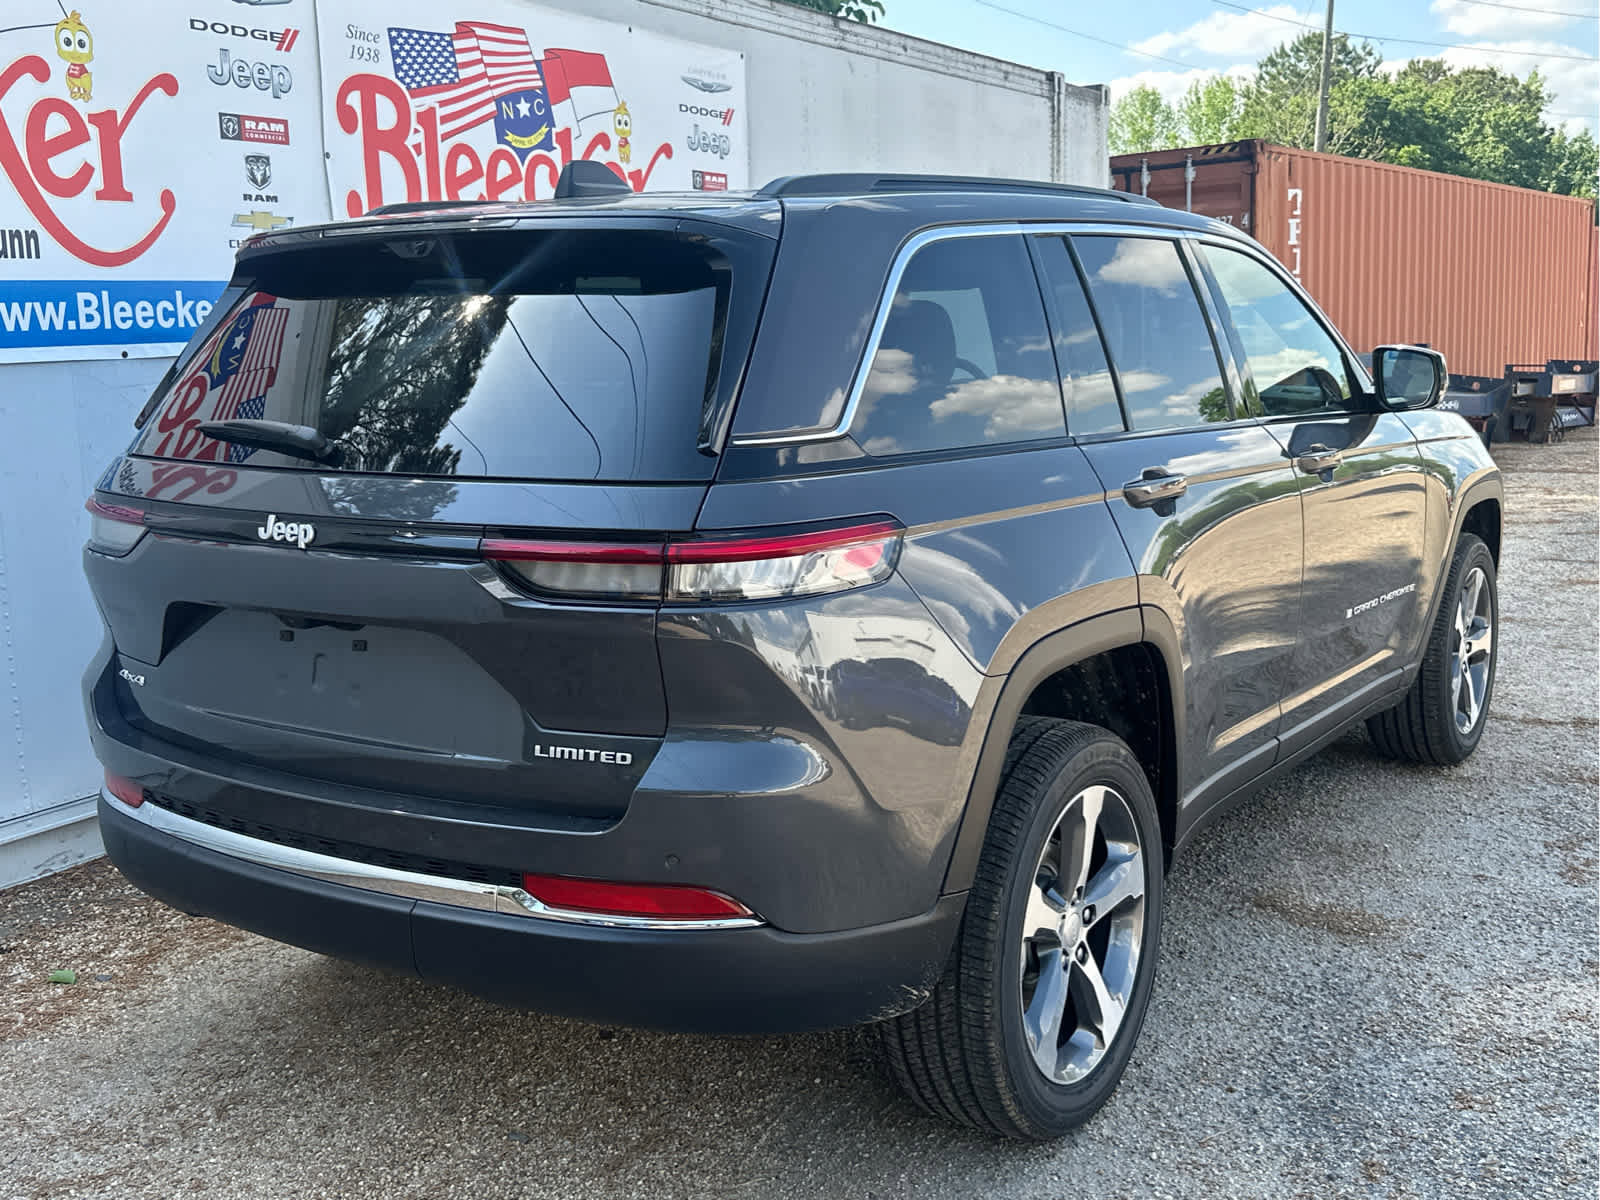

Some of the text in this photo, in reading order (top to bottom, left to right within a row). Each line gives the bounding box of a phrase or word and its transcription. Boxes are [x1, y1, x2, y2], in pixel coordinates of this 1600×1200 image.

[190, 18, 285, 43] DODGE
[345, 23, 380, 43] Since
[350, 45, 380, 63] 1938
[206, 48, 293, 99] Jeep
[502, 98, 545, 119] N C
[679, 103, 727, 119] DODGE
[244, 120, 285, 132] RAM
[336, 73, 673, 219] Bleecr
[687, 123, 730, 160] Jeep
[243, 193, 279, 203] RAM
[258, 514, 315, 549] Jeep
[119, 668, 145, 687] 4x4
[534, 744, 632, 765] LIMITED
